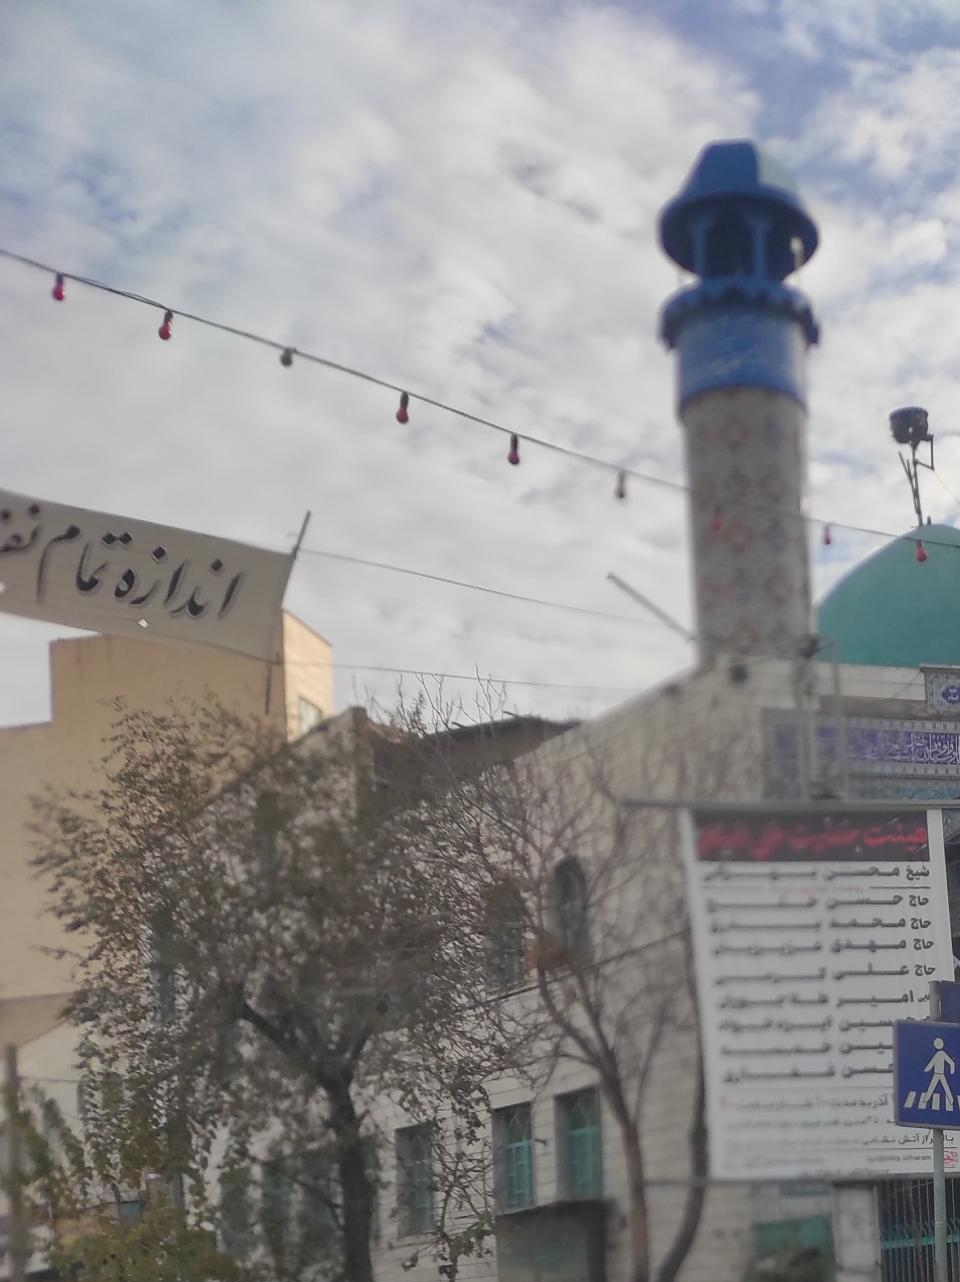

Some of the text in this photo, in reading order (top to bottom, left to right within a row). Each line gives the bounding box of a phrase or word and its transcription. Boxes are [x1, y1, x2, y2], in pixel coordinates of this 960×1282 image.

[824, 865, 900, 882] محسن
[904, 865, 931, 882] شیخ
[825, 894, 904, 911] حسن
[908, 894, 930, 908] حاج
[829, 917, 907, 929] محمد
[910, 916, 933, 930] حاج
[912, 938, 935, 951] حاج
[832, 962, 910, 981] علی
[913, 963, 937, 977] حاج
[835, 989, 914, 1009] امیر
